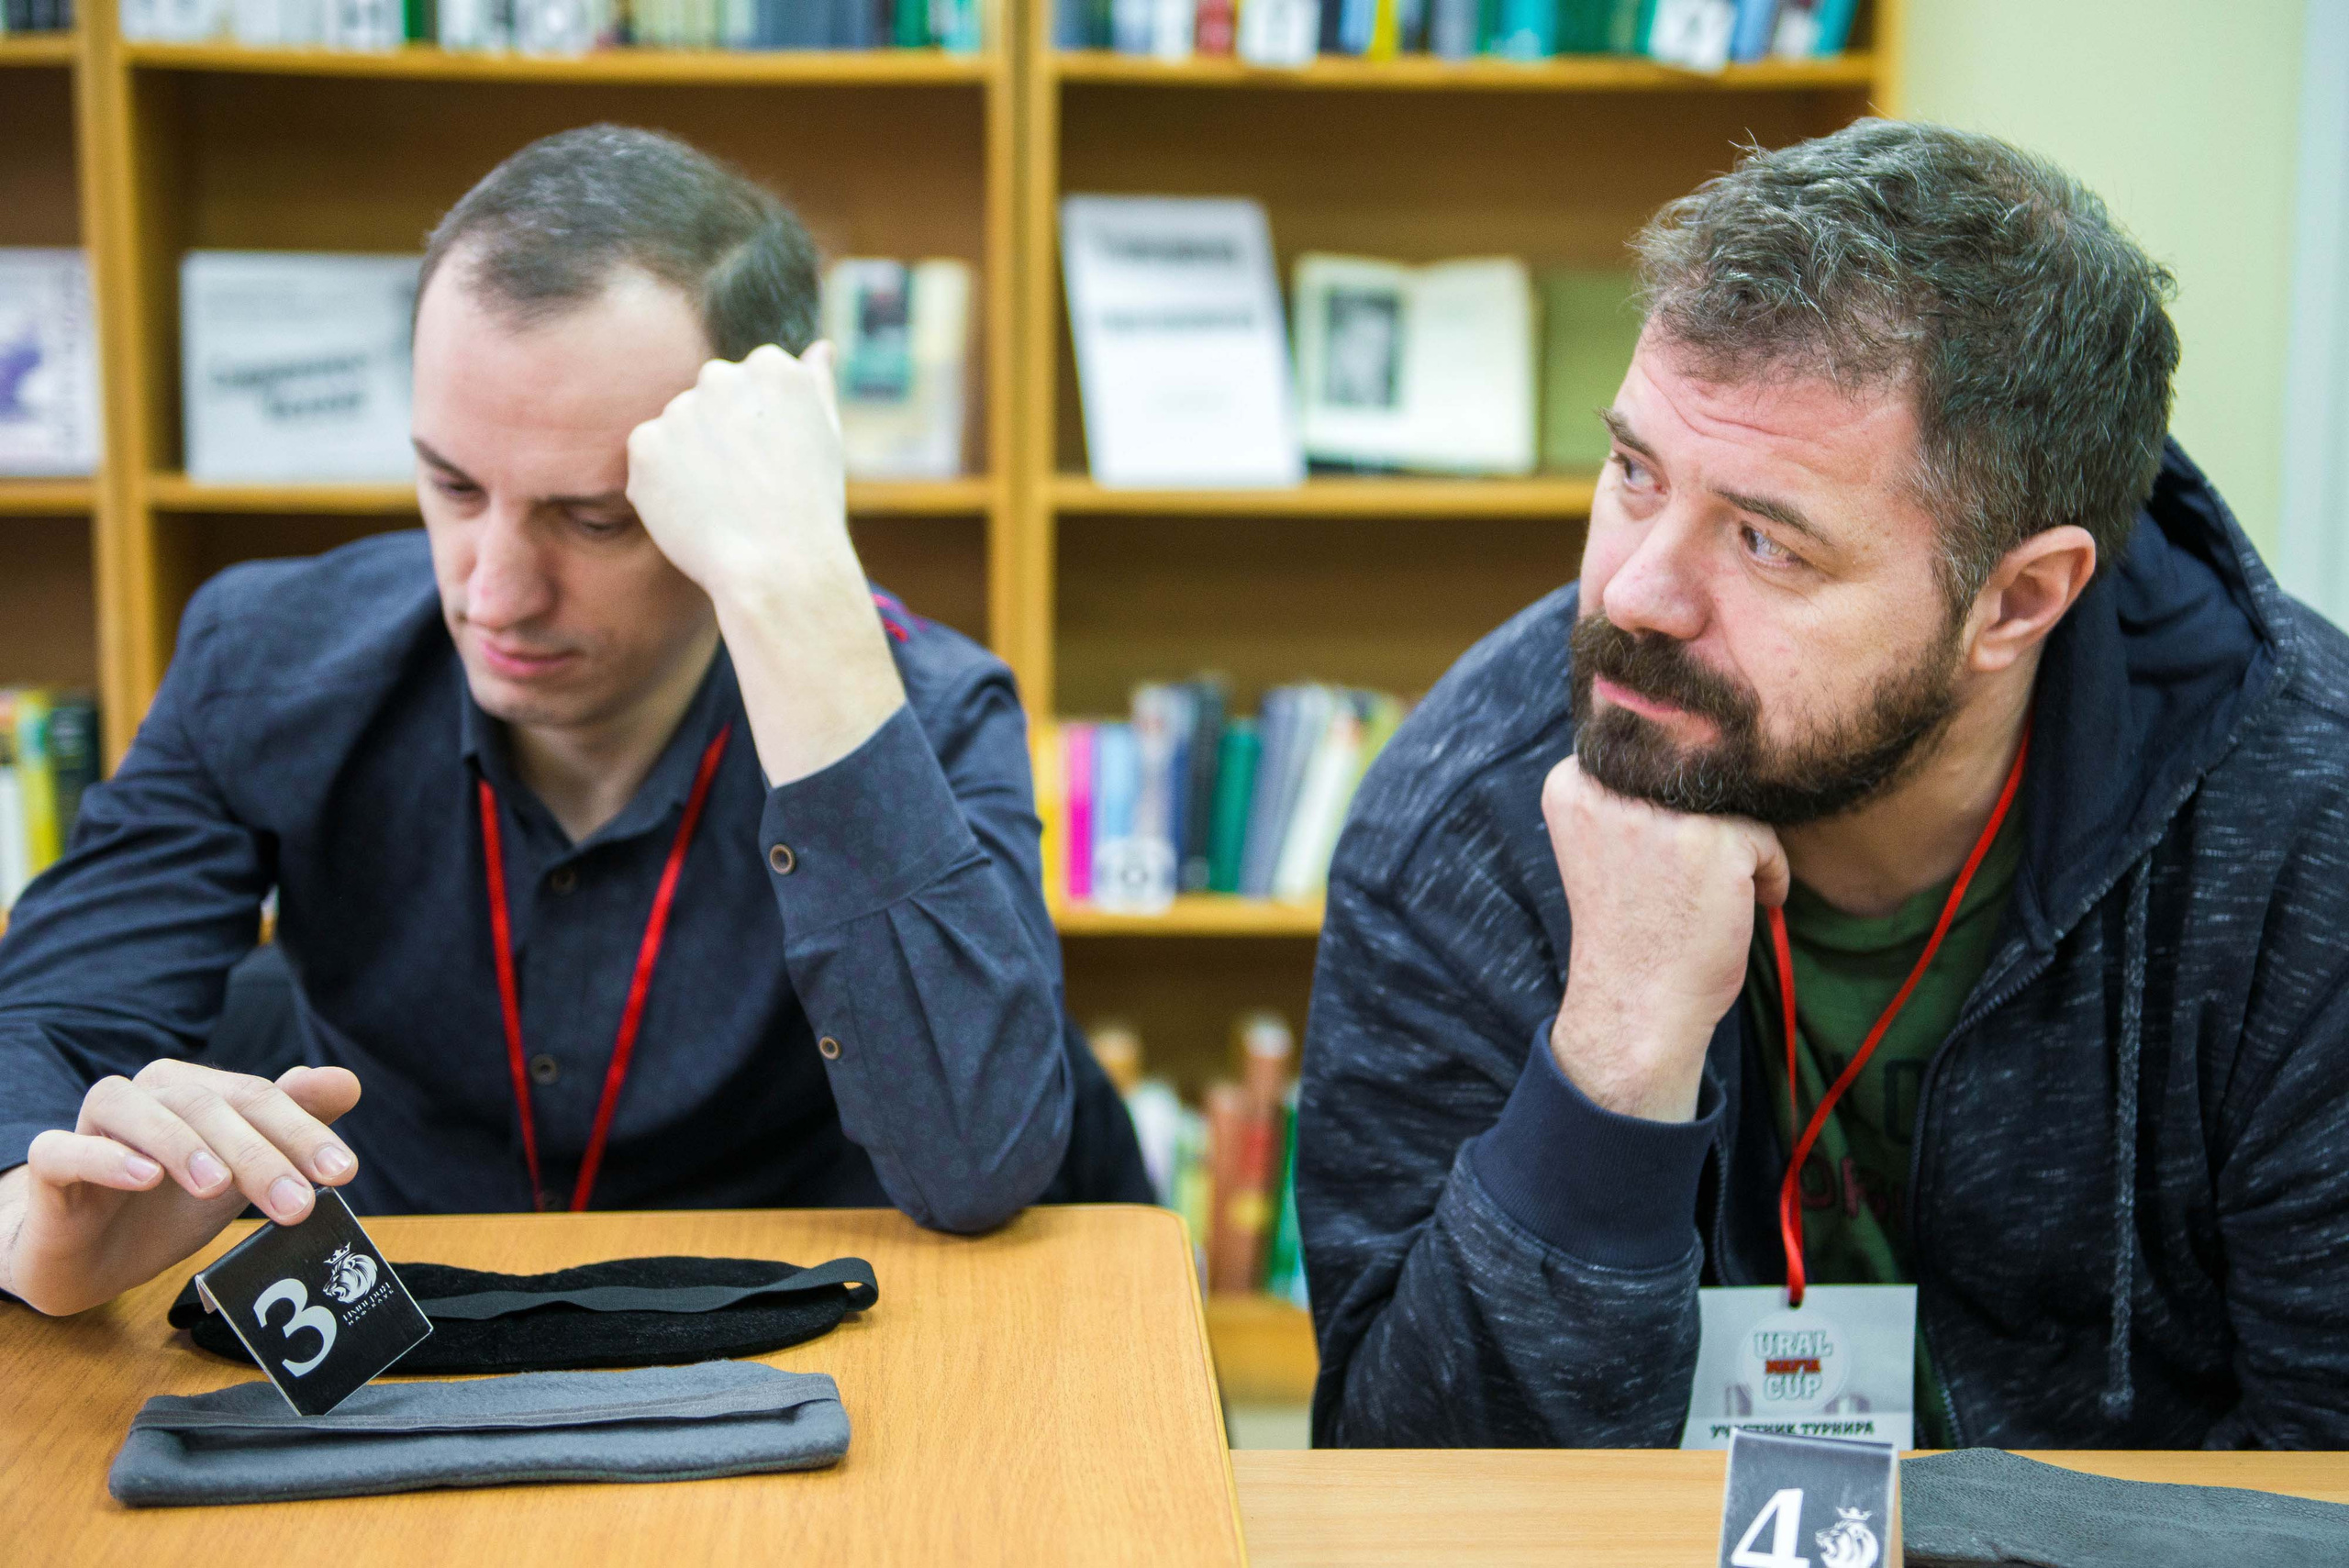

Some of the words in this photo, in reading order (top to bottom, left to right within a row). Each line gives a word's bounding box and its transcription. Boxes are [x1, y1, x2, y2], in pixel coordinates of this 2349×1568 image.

[253, 1278, 337, 1377] 3
[1753, 1330, 1833, 1358] URAL
[1764, 1374, 1822, 1401] CUP
[1799, 1420, 1875, 1436] ТУРНИРА
[1731, 1487, 1810, 1568] 4
